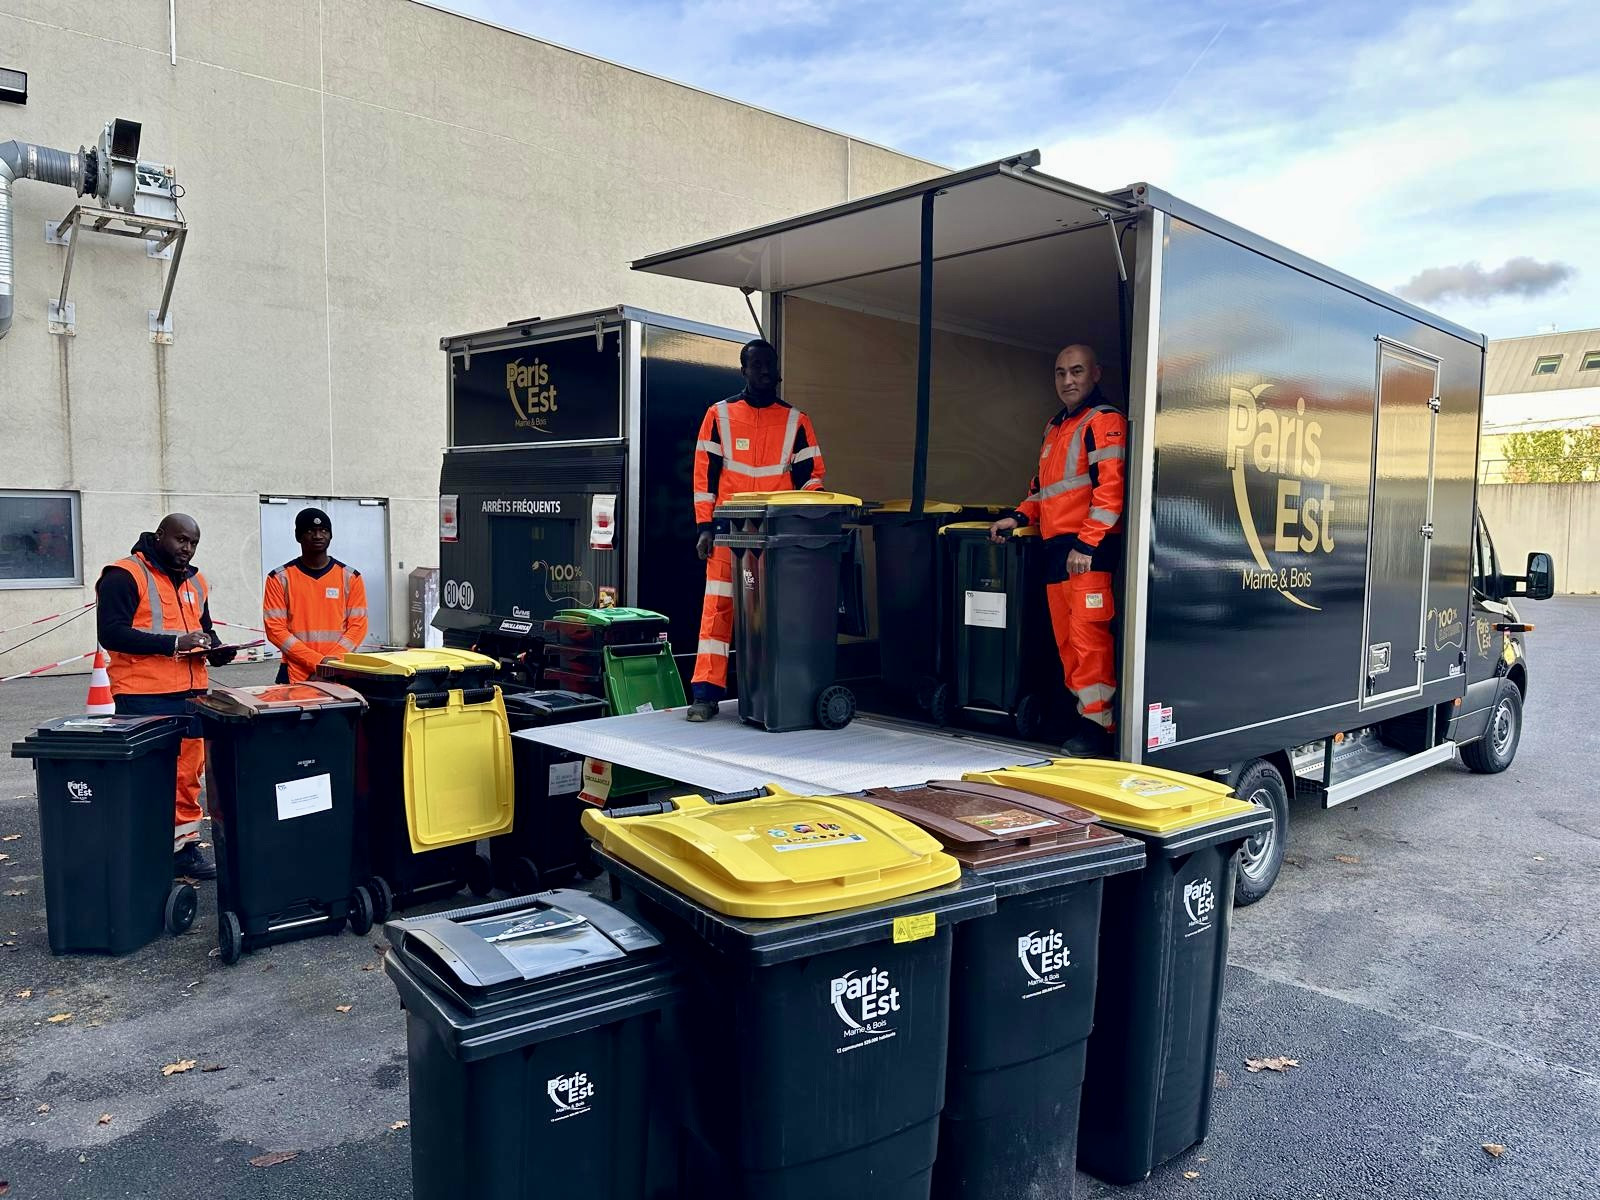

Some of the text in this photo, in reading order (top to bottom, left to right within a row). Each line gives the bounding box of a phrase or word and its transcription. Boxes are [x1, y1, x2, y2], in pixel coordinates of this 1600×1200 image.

[506, 357, 549, 389] Paris
[528, 384, 558, 413] Est
[1226, 387, 1323, 478] Paris
[481, 498, 561, 514] ARRÊTS FRÉQUENTS
[1274, 479, 1335, 553] Est
[550, 564, 583, 581] 100%
[1242, 567, 1312, 590] Marne & Bois
[447, 583, 458, 605] 80
[461, 585, 472, 607] 90
[78, 788, 93, 797] Est
[1183, 877, 1211, 903] Paris
[1197, 892, 1215, 915] Est
[1018, 928, 1063, 958] Paris
[1041, 946, 1071, 974] Est
[830, 966, 890, 1005] Paris
[861, 987, 901, 1021] Est
[843, 1019, 887, 1038] Marne & Bois
[547, 1071, 588, 1095] Paris
[568, 1082, 595, 1103] Est
